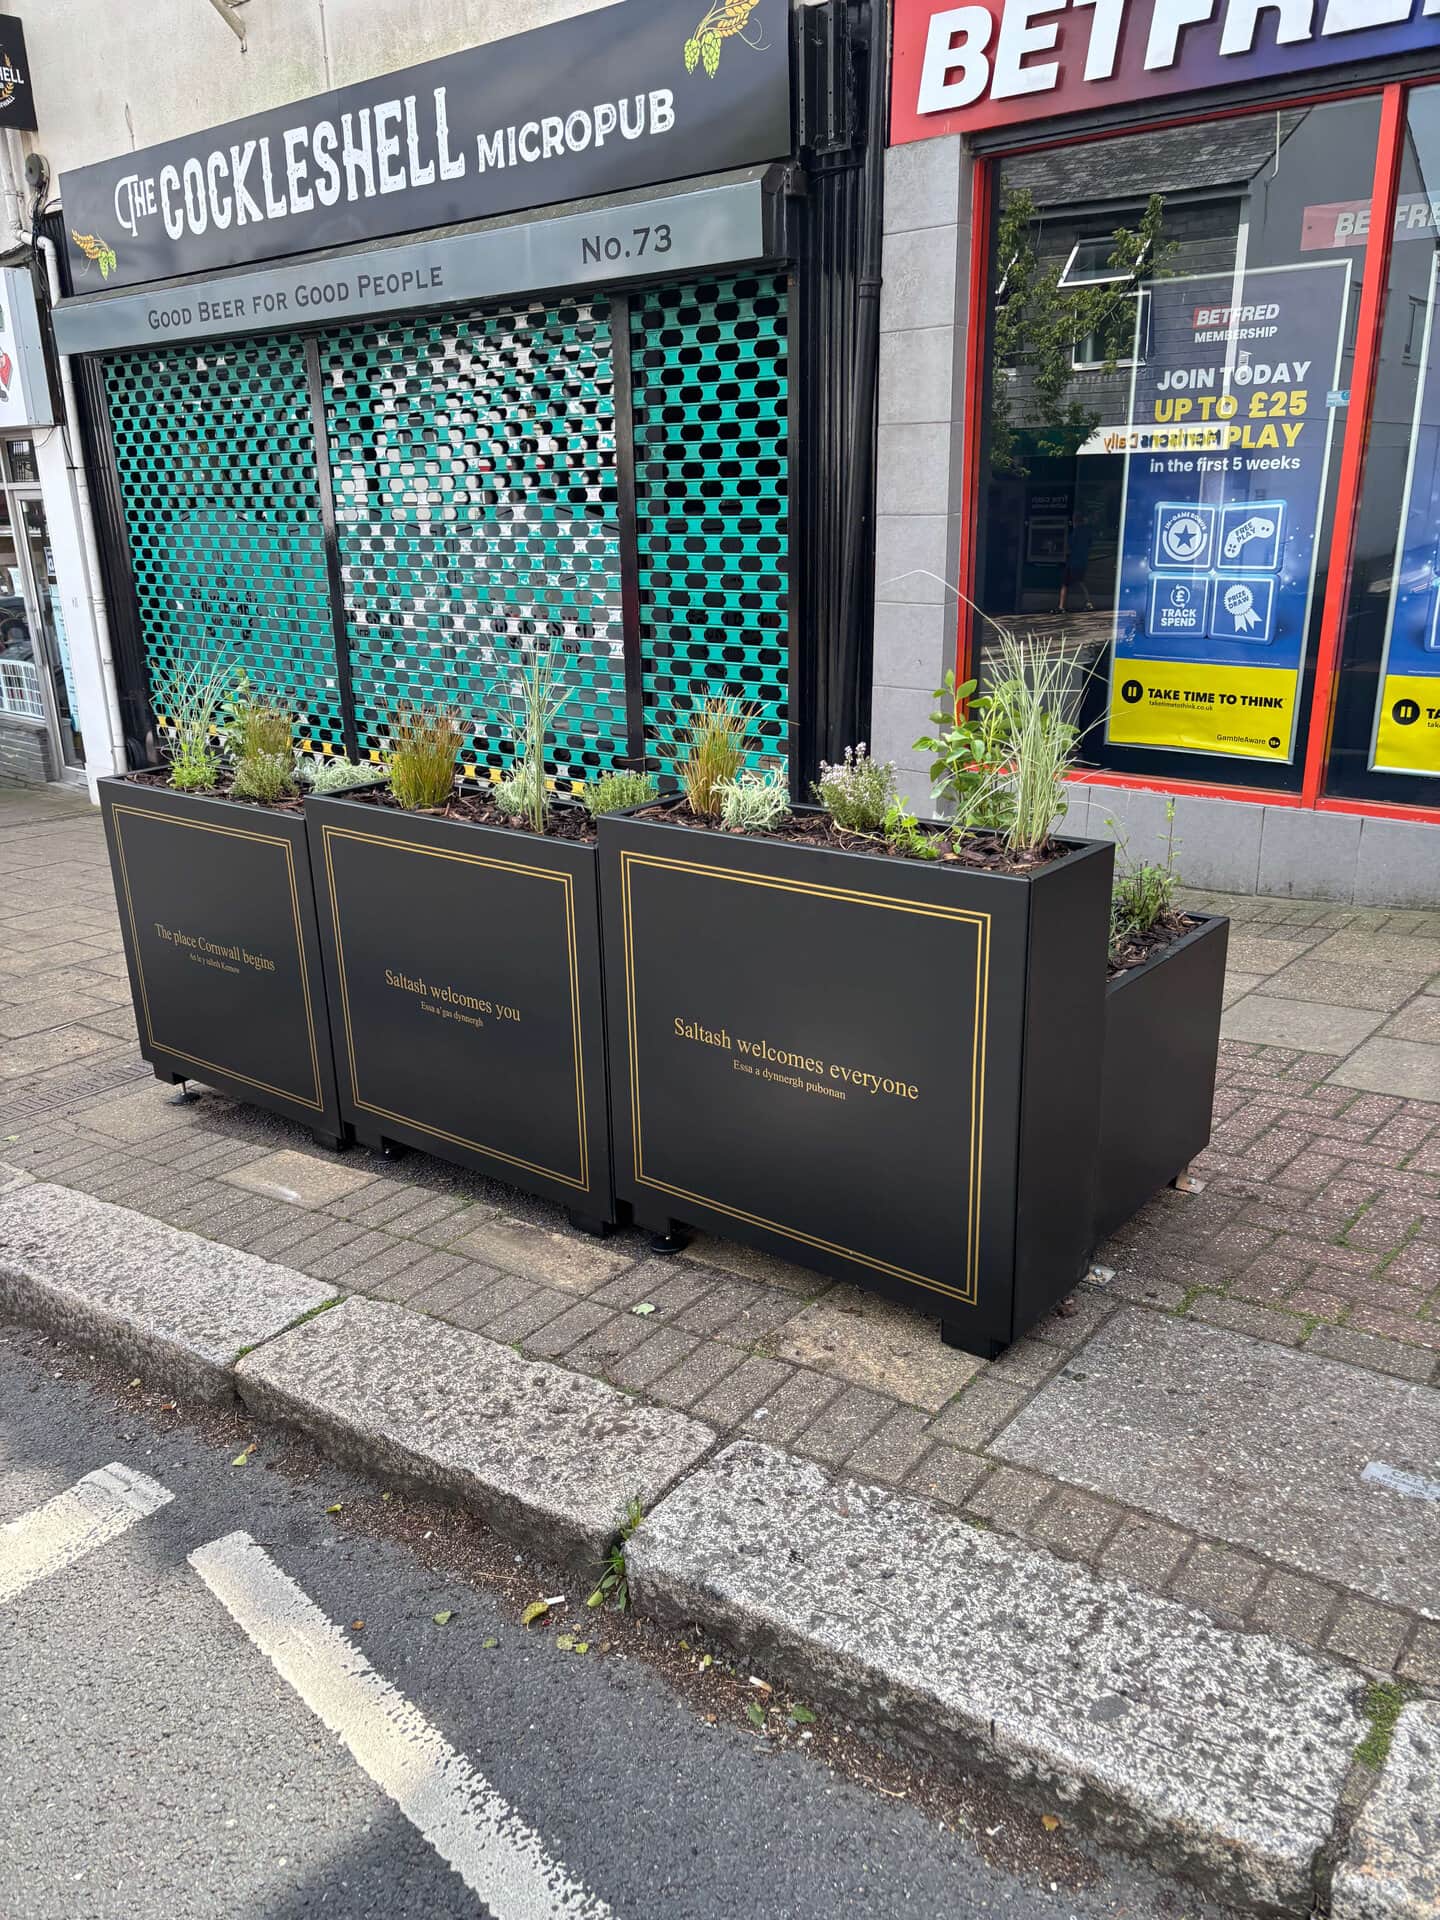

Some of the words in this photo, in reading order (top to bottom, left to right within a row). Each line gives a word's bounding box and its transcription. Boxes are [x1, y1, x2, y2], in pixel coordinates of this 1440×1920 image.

[114, 174, 157, 237] THE
[159, 86, 465, 240] COCKLESHELL
[476, 88, 675, 173] MICROPUB
[148, 307, 192, 330] GOOD
[199, 299, 246, 322] BEER
[252, 292, 287, 315] FOR
[295, 282, 349, 308] GOOD
[357, 266, 444, 298] PEOPLE
[1197, 304, 1280, 325] BETFRED
[1194, 326, 1278, 343] MEMBERSHIP
[1157, 368, 1215, 390] JOIN
[1220, 361, 1311, 387] TODAY
[1154, 398, 1192, 423] UP
[1198, 395, 1238, 420] TO
[1248, 390, 1307, 418] £25
[1223, 422, 1304, 449] PLAY
[1150, 459, 1164, 472] in
[1167, 458, 1192, 472] the
[1196, 457, 1228, 471] first
[1232, 457, 1242, 470] 5
[1245, 456, 1300, 470] weeks
[1235, 522, 1252, 537] FREE
[1237, 528, 1256, 543] PLAY
[1227, 590, 1246, 602] PRIZE
[1228, 596, 1250, 609] DRAW
[1160, 618, 1196, 627] SPEND
[1161, 609, 1197, 618] TRACK
[1148, 688, 1179, 701] TAKE
[1184, 691, 1215, 703] TIME
[1219, 694, 1237, 705] TO
[1240, 696, 1284, 709] THINK
[1149, 700, 1213, 711] taketimetothink.co.uk
[1217, 734, 1266, 745] GambleAware
[154, 922, 172, 940] The
[173, 930, 197, 947] place
[198, 937, 240, 961] Cornwall
[242, 948, 275, 971] begins
[385, 968, 427, 995] Saltash
[430, 985, 492, 1014] welcomes
[495, 1003, 521, 1022] you
[674, 1017, 731, 1049] Saltash
[737, 1040, 824, 1074] welcomes
[830, 1062, 919, 1100] everyone
[733, 1059, 753, 1074] Essa
[755, 1067, 761, 1076] a
[762, 1067, 804, 1089] dynnergh
[806, 1080, 846, 1101] pubonan
